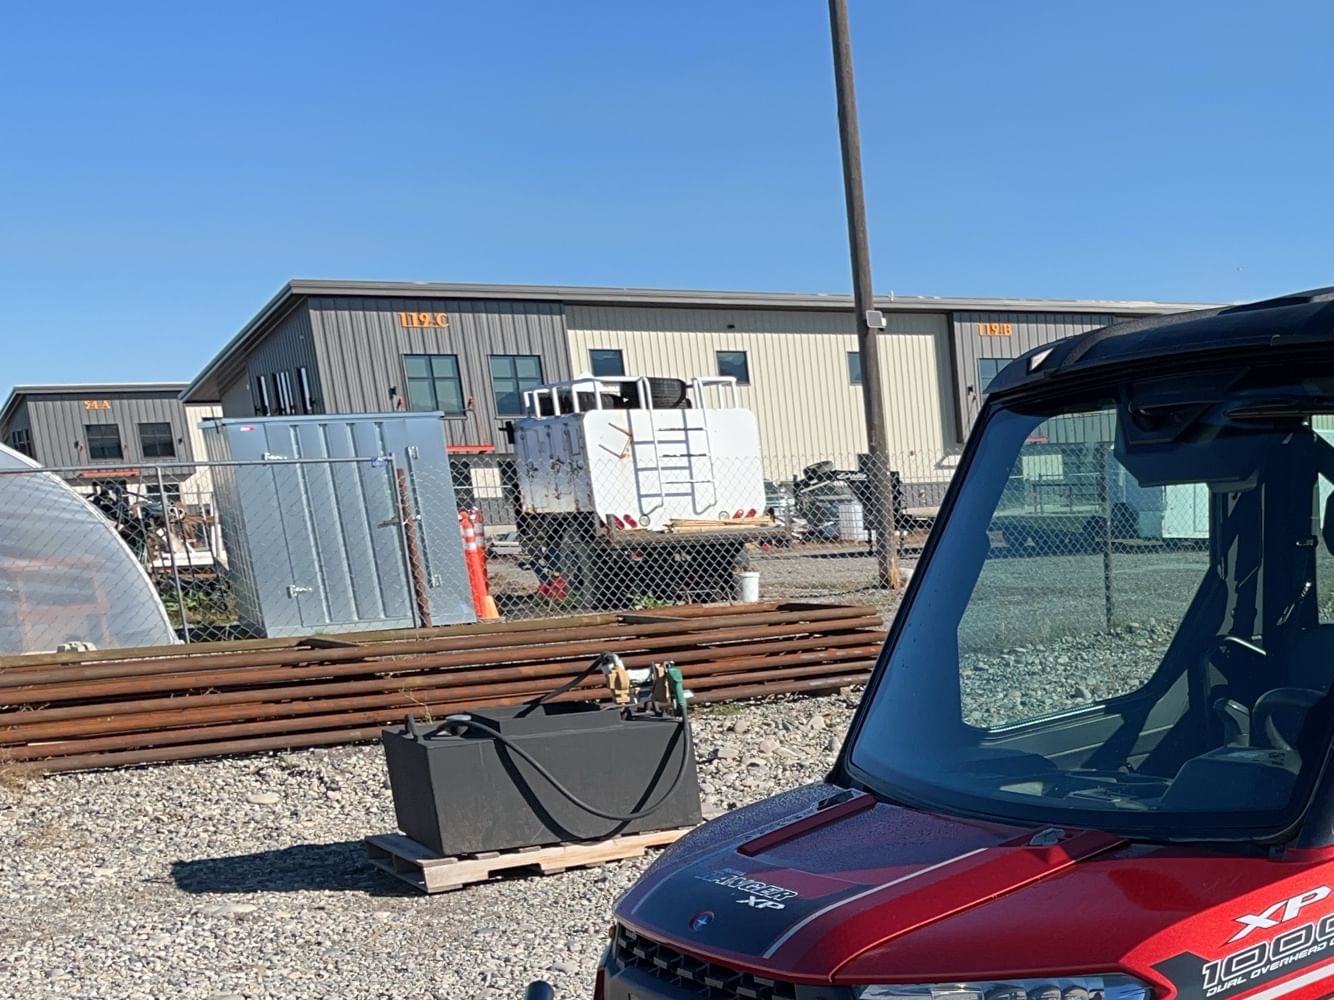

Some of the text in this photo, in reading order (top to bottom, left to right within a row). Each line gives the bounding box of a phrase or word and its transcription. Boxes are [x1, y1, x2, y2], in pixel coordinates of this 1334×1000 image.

[736, 895, 785, 910] XP
[1220, 885, 1333, 946] XP
[1206, 976, 1247, 997] DUAL
[1250, 944, 1327, 979] OVERHEAD
